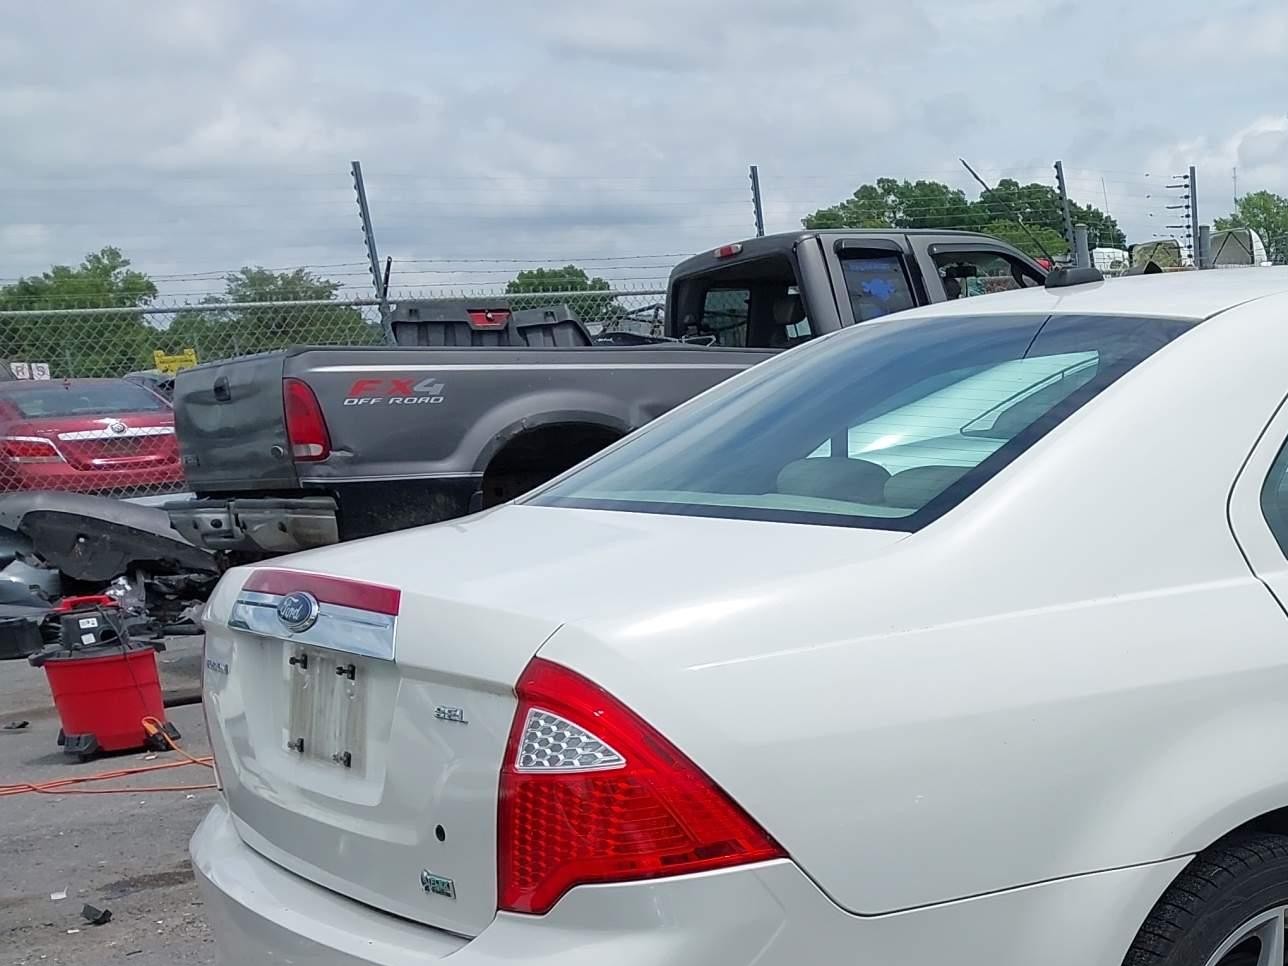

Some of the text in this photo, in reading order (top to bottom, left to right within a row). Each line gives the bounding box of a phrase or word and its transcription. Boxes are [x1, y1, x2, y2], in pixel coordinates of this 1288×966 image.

[350, 378, 445, 396] FX4
[343, 396, 444, 406] OFF ROAD
[280, 597, 304, 620] Ford
